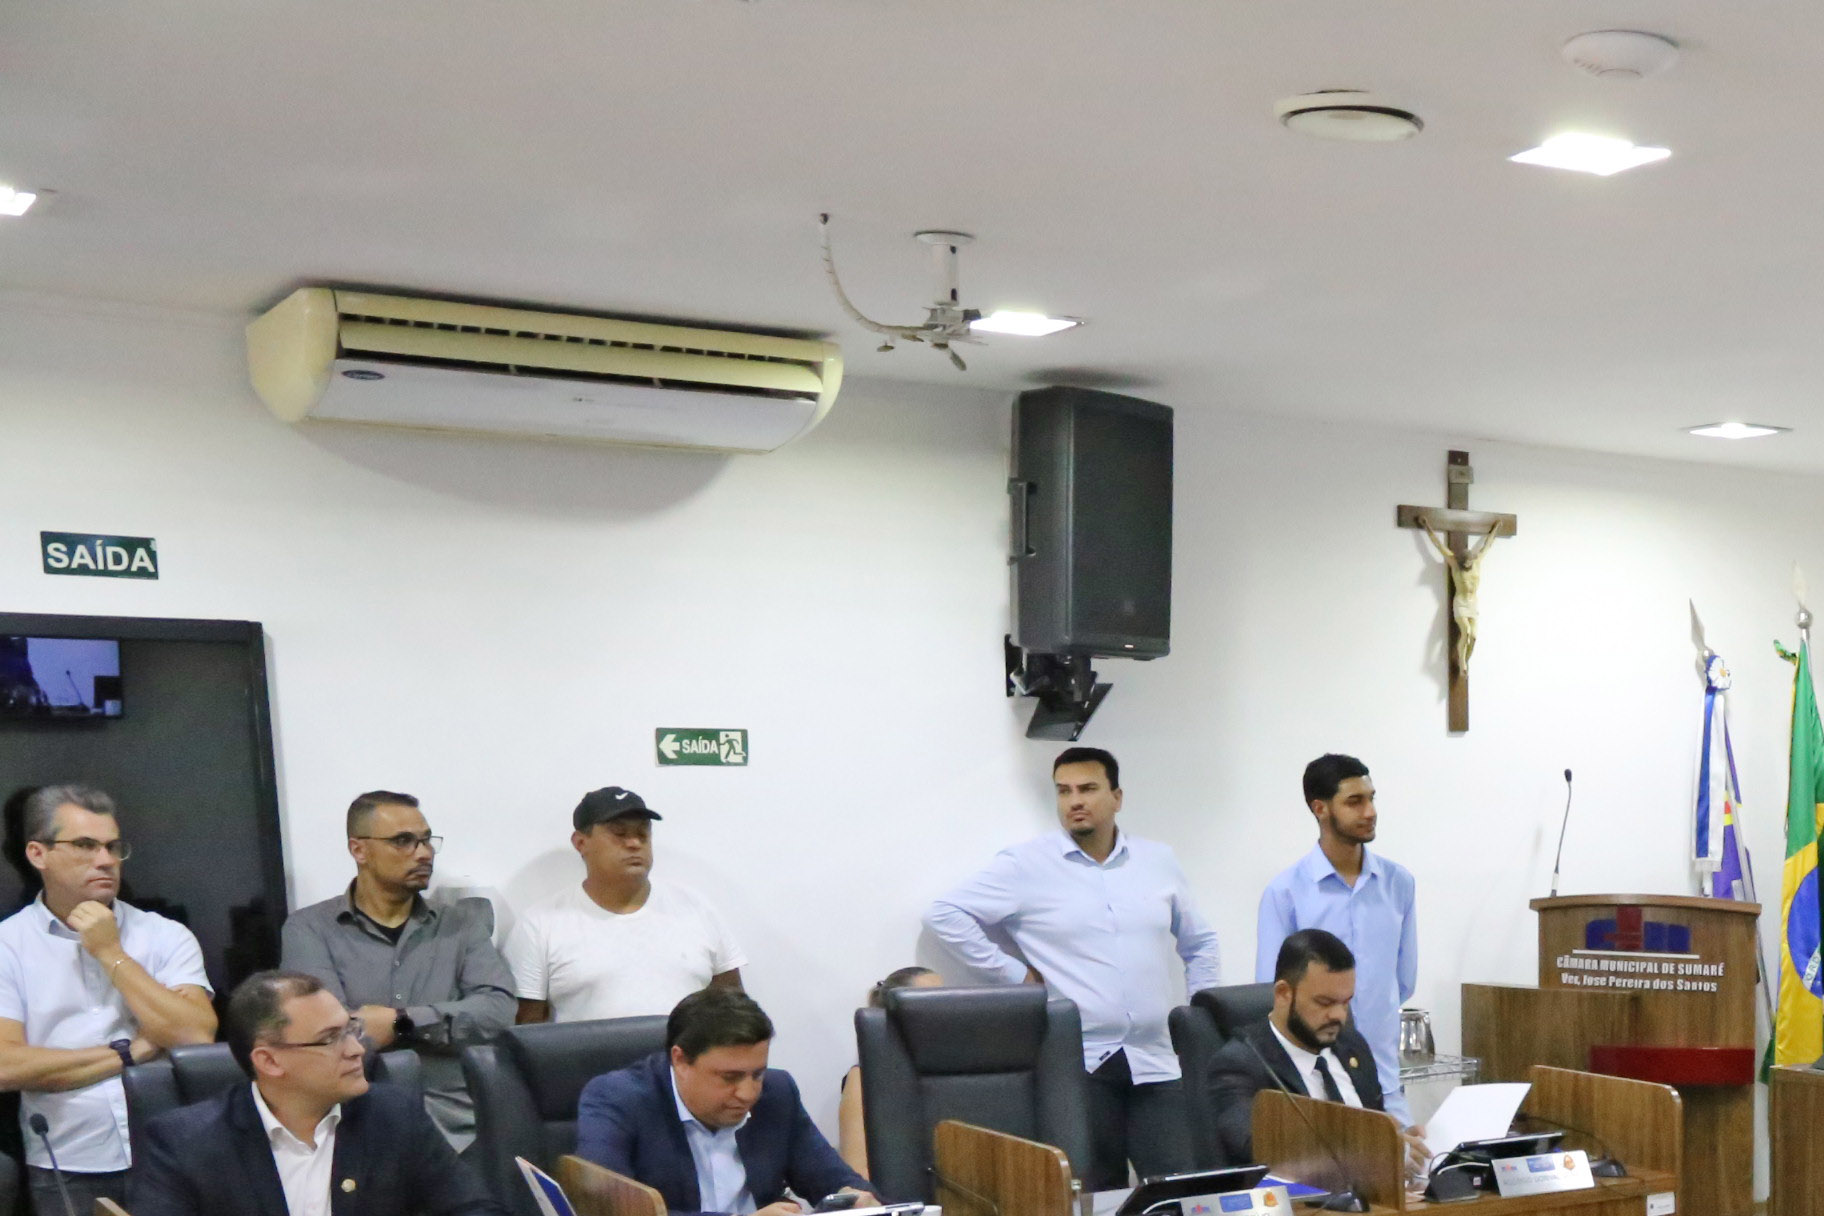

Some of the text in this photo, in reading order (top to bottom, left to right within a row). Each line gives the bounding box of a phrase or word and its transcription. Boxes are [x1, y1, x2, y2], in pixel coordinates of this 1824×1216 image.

[47, 540, 155, 572] SAÍDA
[682, 735, 719, 754] SAÍDA
[1556, 954, 1725, 977] CÂMARA MUNICIPAL DE SUMARÉ
[1608, 975, 1650, 989] Pereira
[1652, 978, 1674, 990] dos
[1676, 979, 1718, 992] Santos
